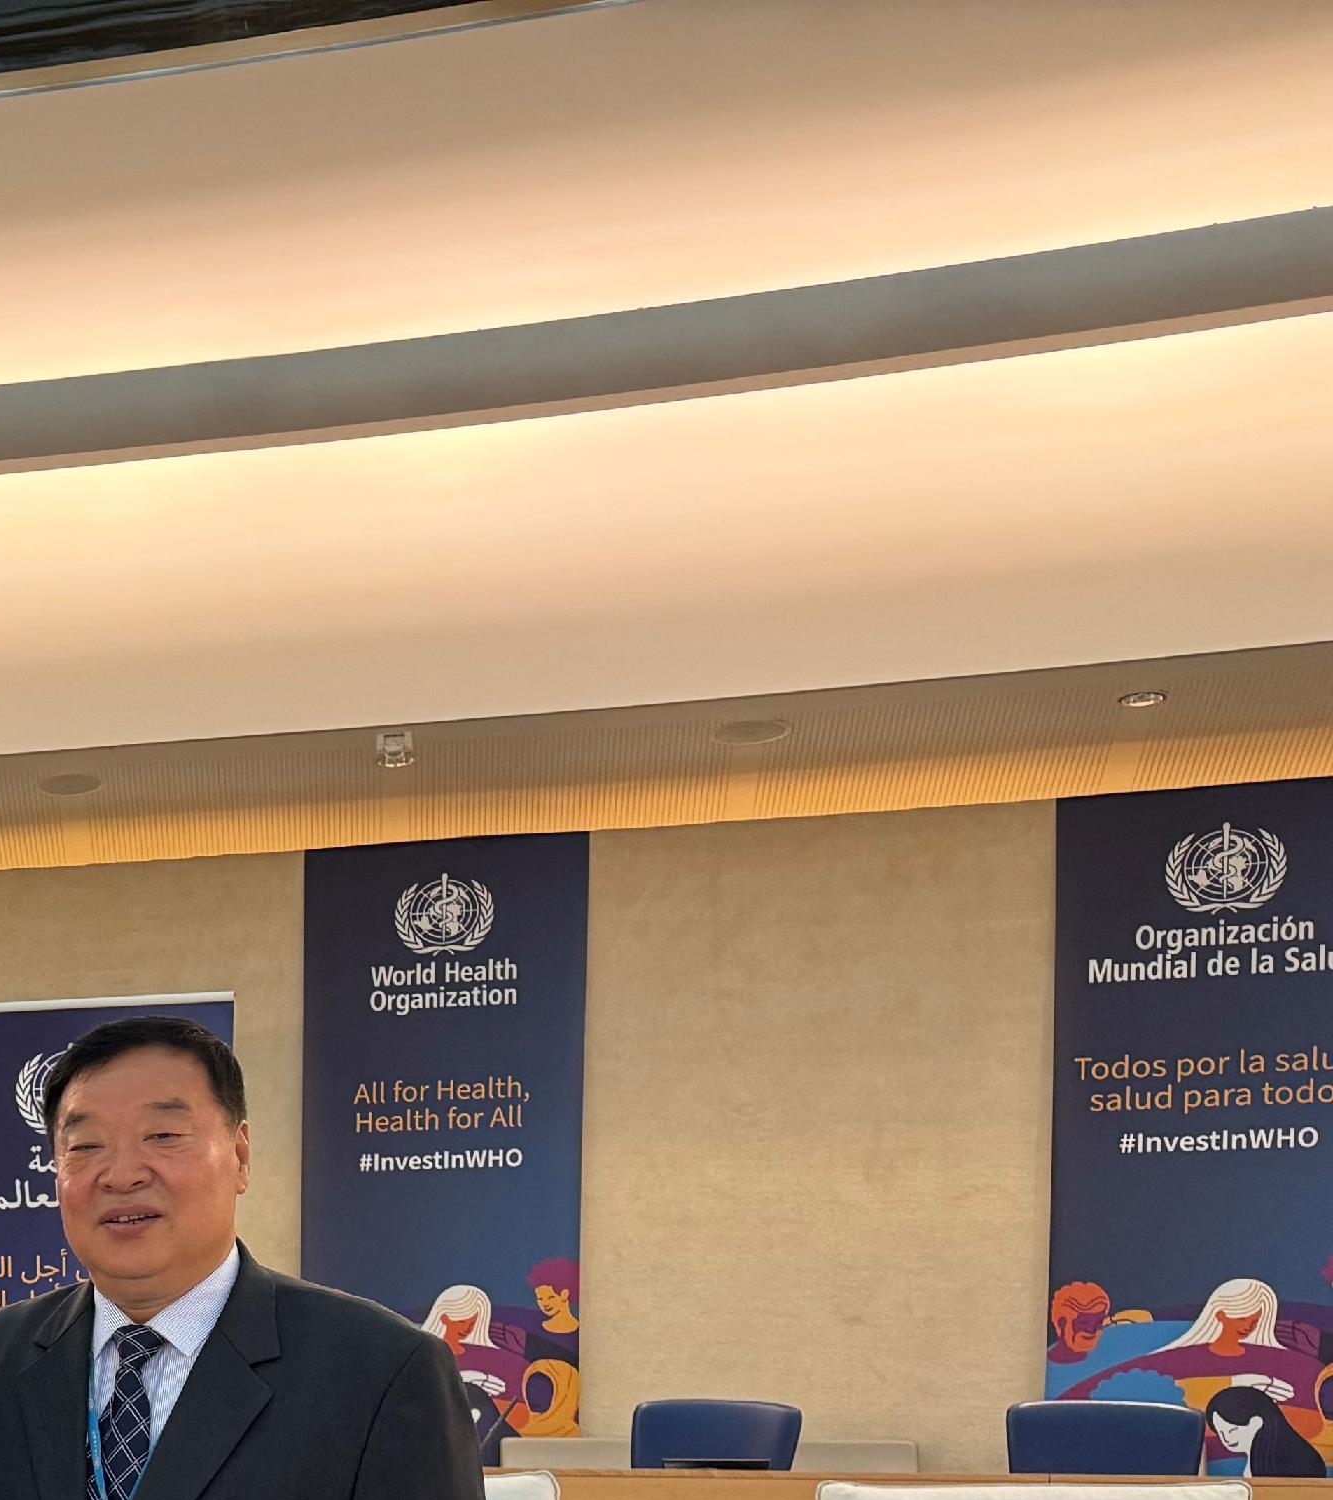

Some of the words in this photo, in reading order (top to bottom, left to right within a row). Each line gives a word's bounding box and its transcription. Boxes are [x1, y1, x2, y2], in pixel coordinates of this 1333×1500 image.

[1135, 915, 1314, 955] Organización
[371, 961, 435, 987] World
[445, 958, 518, 983] Health
[1088, 952, 1197, 984] Mundial
[1206, 950, 1241, 977] de
[1250, 947, 1274, 975] la
[369, 984, 518, 1016] Organization
[1074, 1054, 1167, 1081] Todos
[1177, 1055, 1230, 1083] por
[1240, 1048, 1265, 1075] la
[353, 1081, 386, 1105] All
[393, 1080, 430, 1103] for
[436, 1076, 531, 1102] Health,
[1090, 1084, 1173, 1112] salud
[1184, 1087, 1253, 1114] para
[1262, 1078, 1333, 1105] todo
[355, 1108, 439, 1133] Health
[447, 1106, 485, 1130] for
[490, 1104, 522, 1128] All
[1119, 1126, 1319, 1154] #InvestInWHO
[359, 1147, 523, 1172] #InvestInWHO
[20, 1248, 68, 1285] أجل
